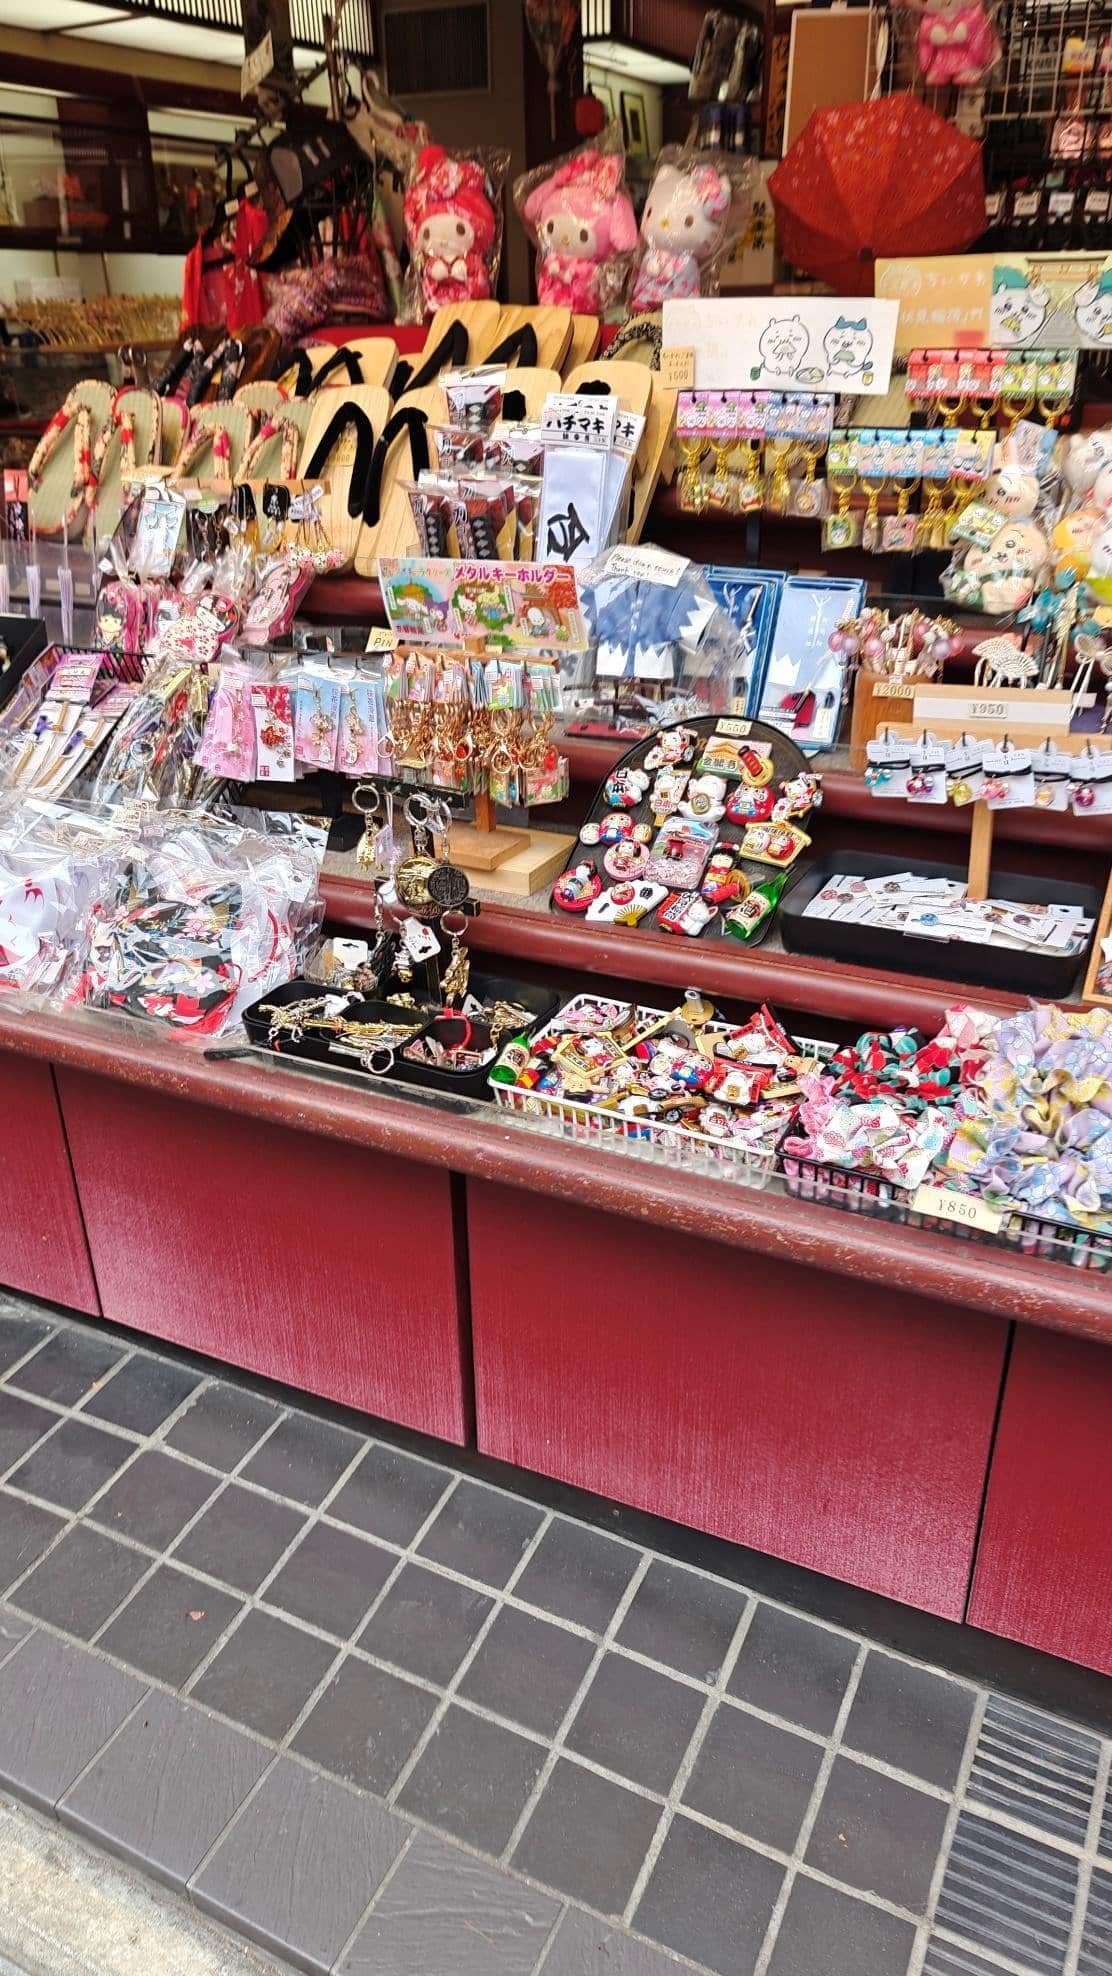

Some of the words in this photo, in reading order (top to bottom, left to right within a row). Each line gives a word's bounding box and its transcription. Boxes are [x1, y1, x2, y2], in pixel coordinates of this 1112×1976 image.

[546, 415, 606, 434] ハチマキ
[454, 565, 571, 583] メタルキーホルダー
[937, 1199, 977, 1219] ¥850
